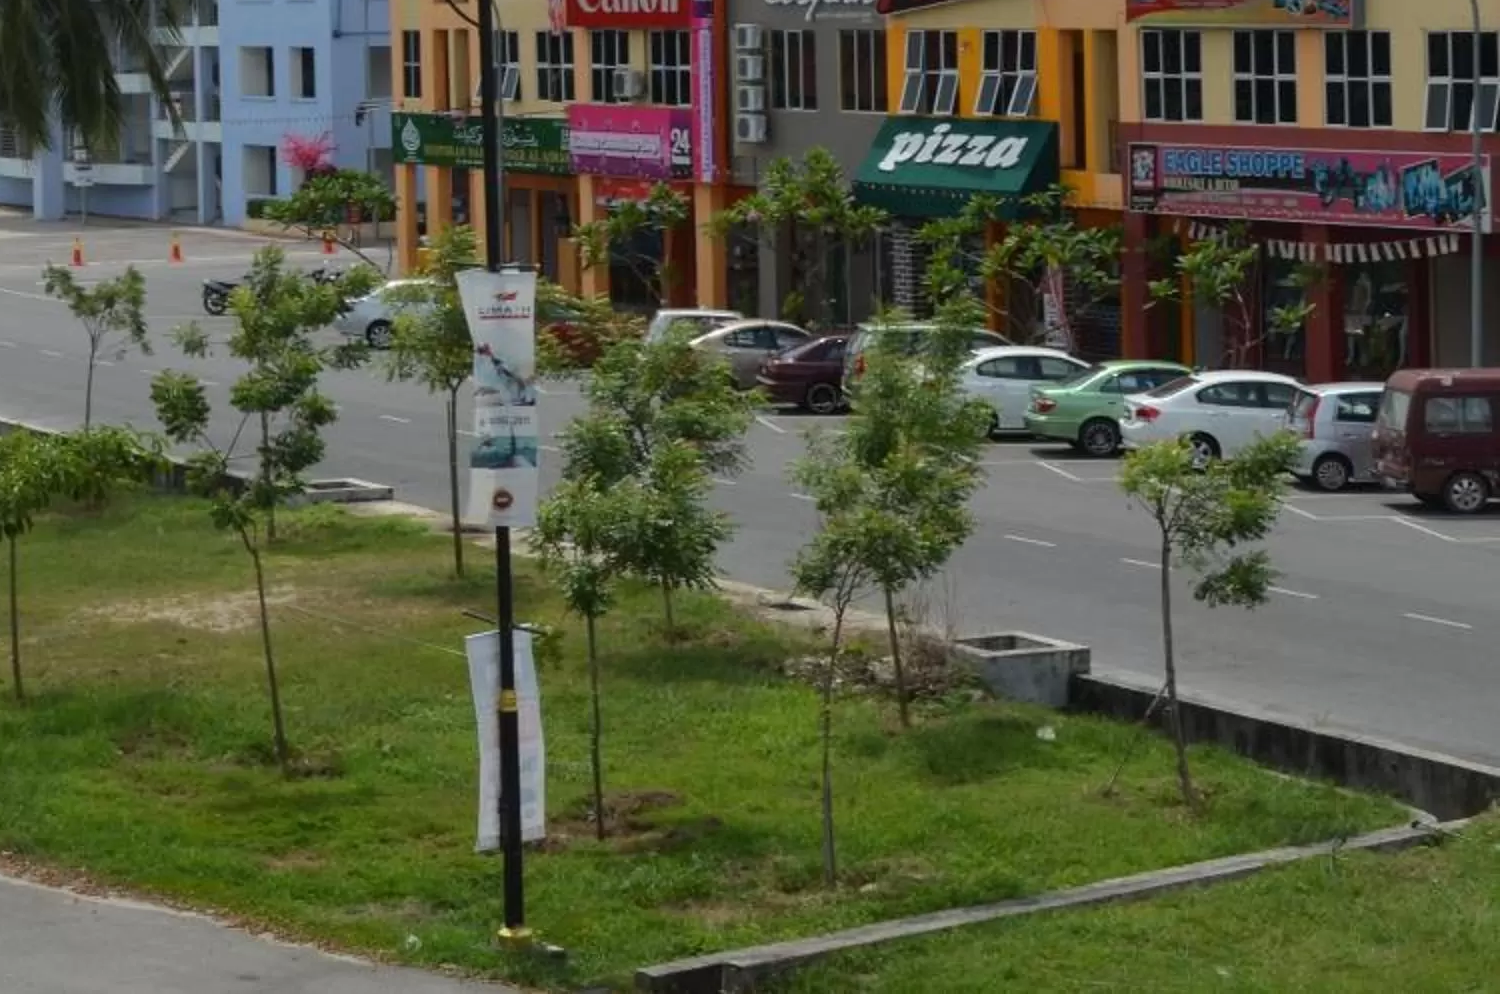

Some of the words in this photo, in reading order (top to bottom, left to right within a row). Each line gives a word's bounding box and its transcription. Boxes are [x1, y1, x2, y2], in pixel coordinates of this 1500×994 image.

[670, 128, 691, 154] 24
[878, 122, 1029, 172] pizza
[1163, 149, 1223, 176] EAGLE
[1226, 150, 1305, 179] SHOPPE
